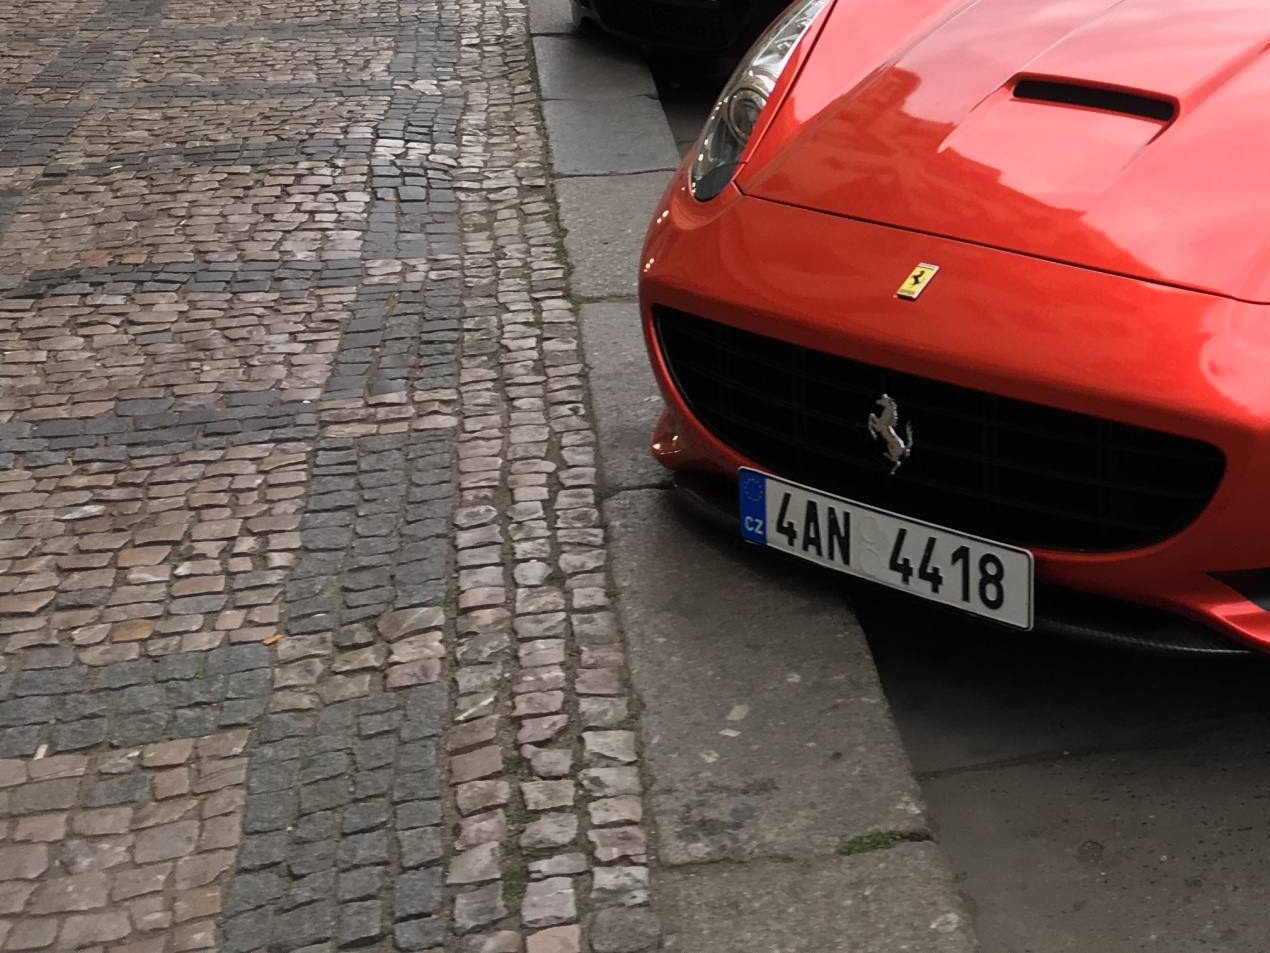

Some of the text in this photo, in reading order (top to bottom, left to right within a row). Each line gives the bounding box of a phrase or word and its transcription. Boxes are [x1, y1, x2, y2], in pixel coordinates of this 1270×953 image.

[744, 515, 764, 536] CZ
[775, 492, 1005, 610] 4AN 4418
